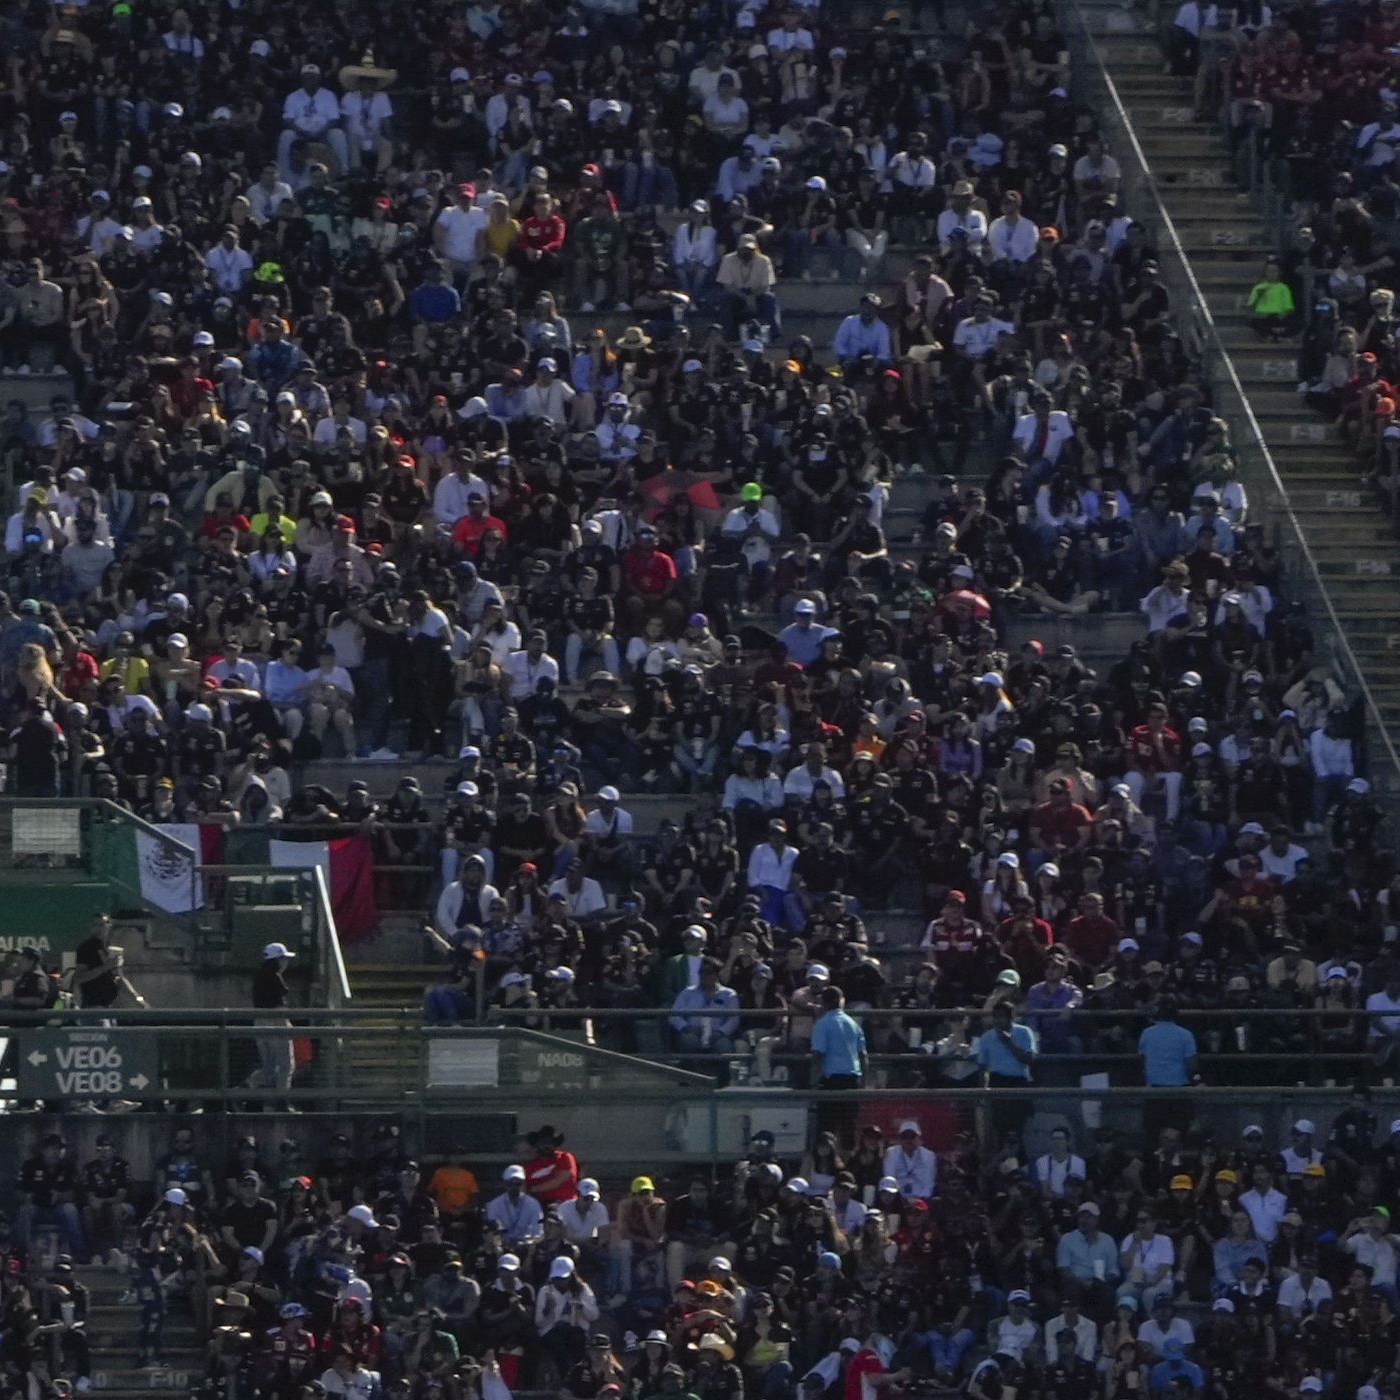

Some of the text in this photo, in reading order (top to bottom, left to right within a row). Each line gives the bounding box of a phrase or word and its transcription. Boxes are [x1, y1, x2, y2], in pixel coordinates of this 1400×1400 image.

[55, 1046, 122, 1069] VE06
[55, 1071, 122, 1094] VE08
[149, 1371, 189, 1389] F-10
